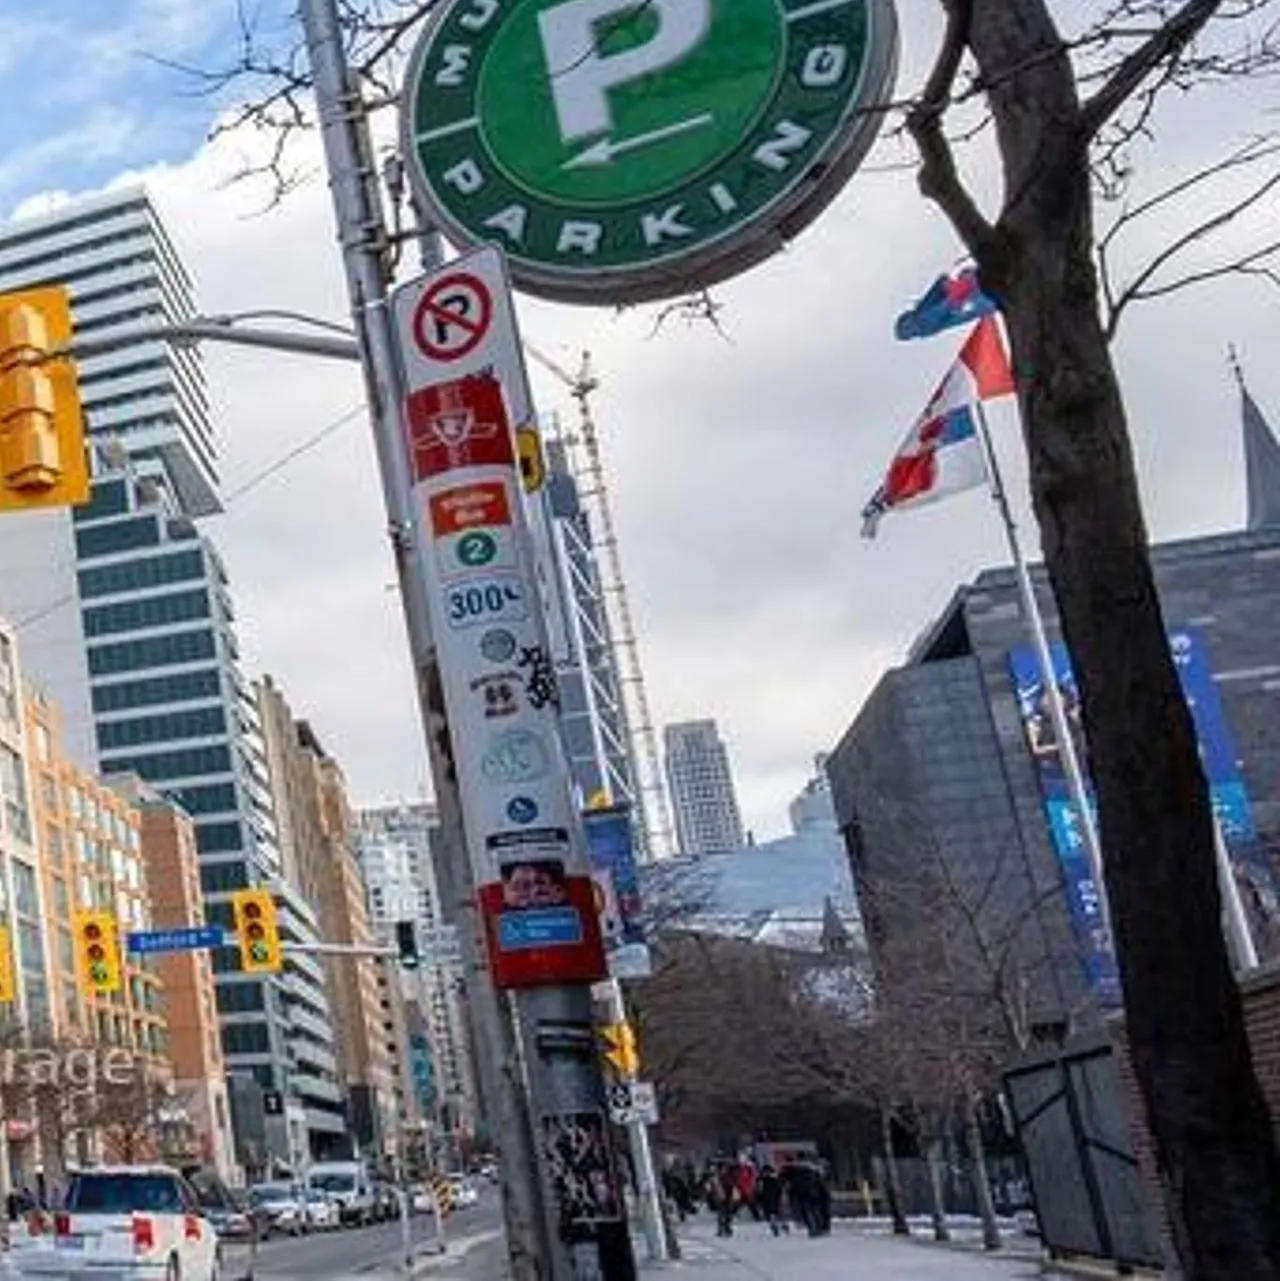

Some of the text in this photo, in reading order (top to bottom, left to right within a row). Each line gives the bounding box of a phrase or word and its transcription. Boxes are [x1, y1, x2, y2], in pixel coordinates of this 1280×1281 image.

[442, 43, 848, 256] PARKING
[466, 539, 487, 560] 2
[450, 584, 504, 620] 300
